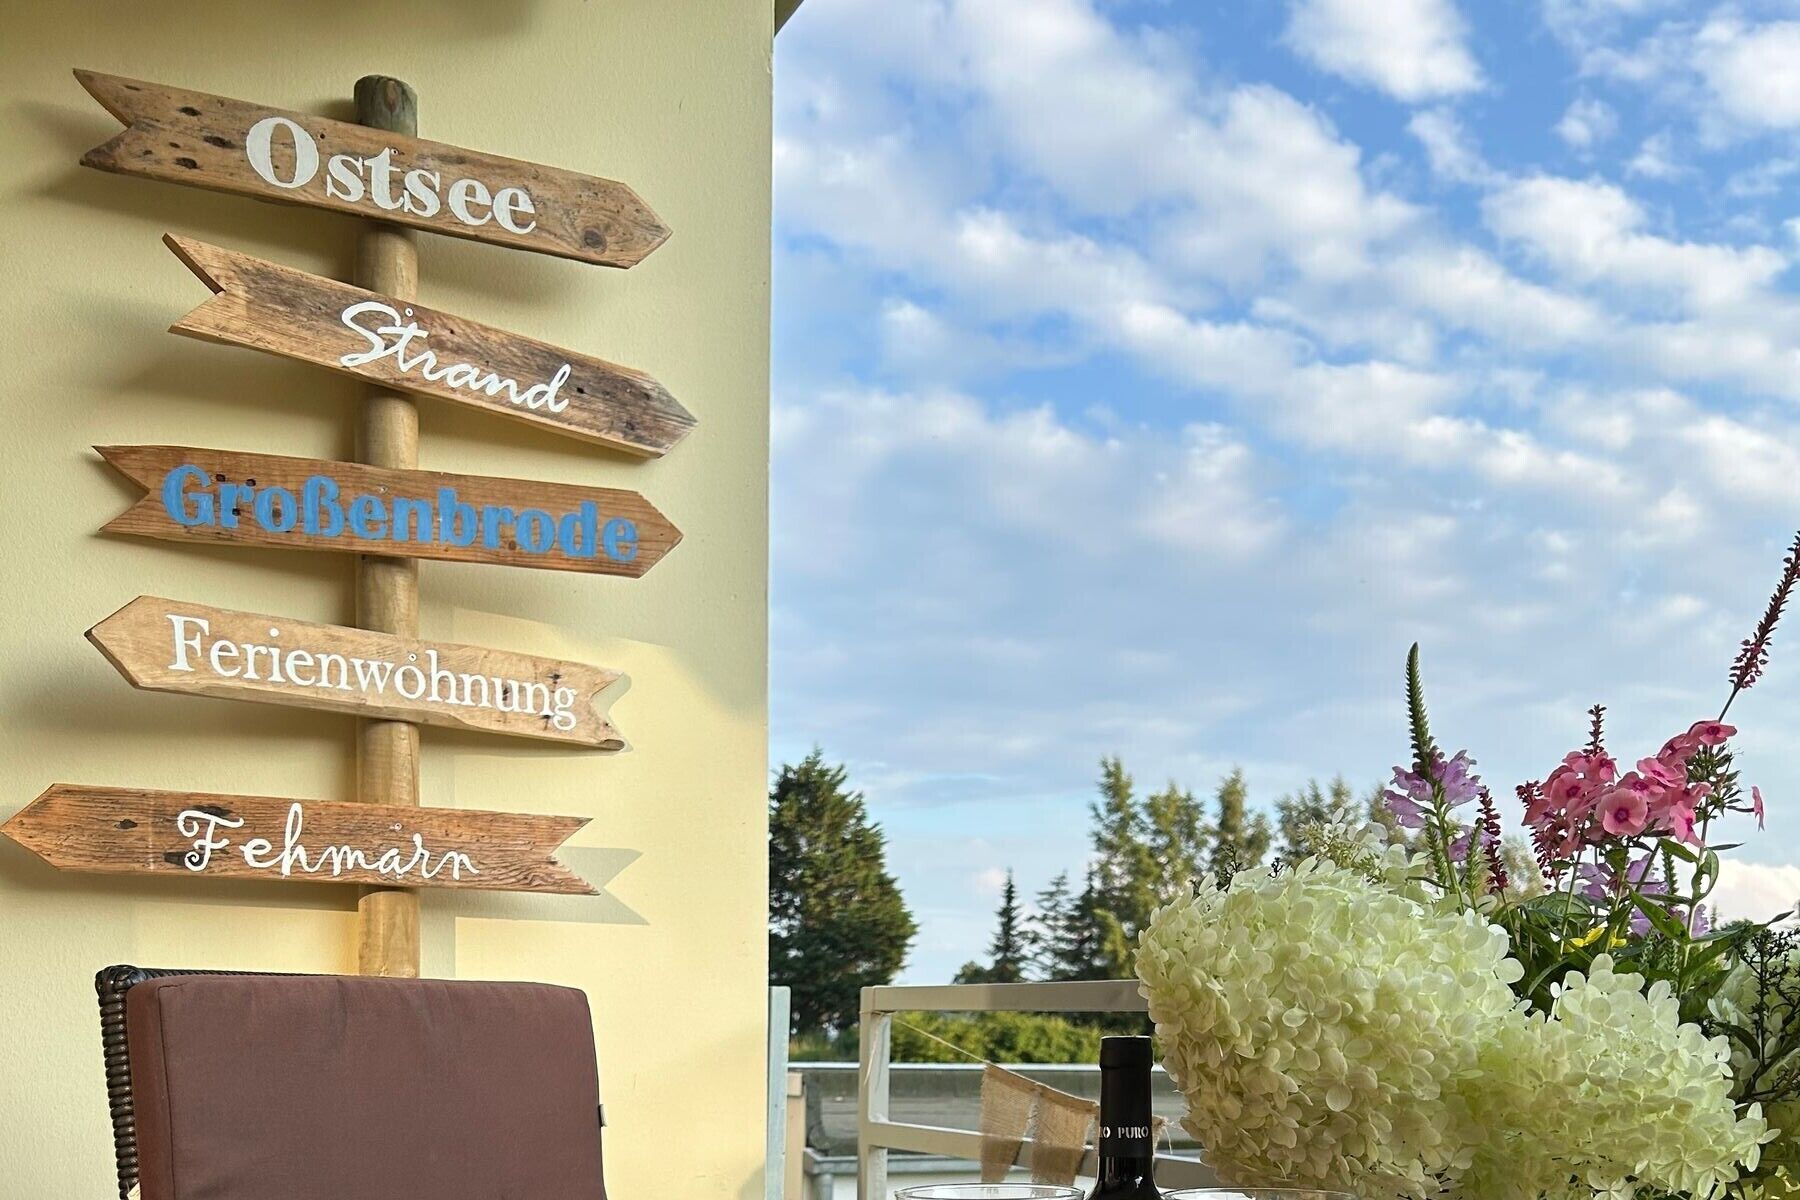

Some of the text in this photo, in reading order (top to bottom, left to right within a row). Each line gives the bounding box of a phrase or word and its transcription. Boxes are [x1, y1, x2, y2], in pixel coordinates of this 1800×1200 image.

[245, 116, 537, 235] Ostsee
[339, 300, 571, 413] Strand
[161, 464, 639, 564] Großenbrode
[165, 613, 577, 730] Ferienwohnung
[176, 802, 479, 878] Fehmarn
[1117, 1126, 1149, 1139] PURO
